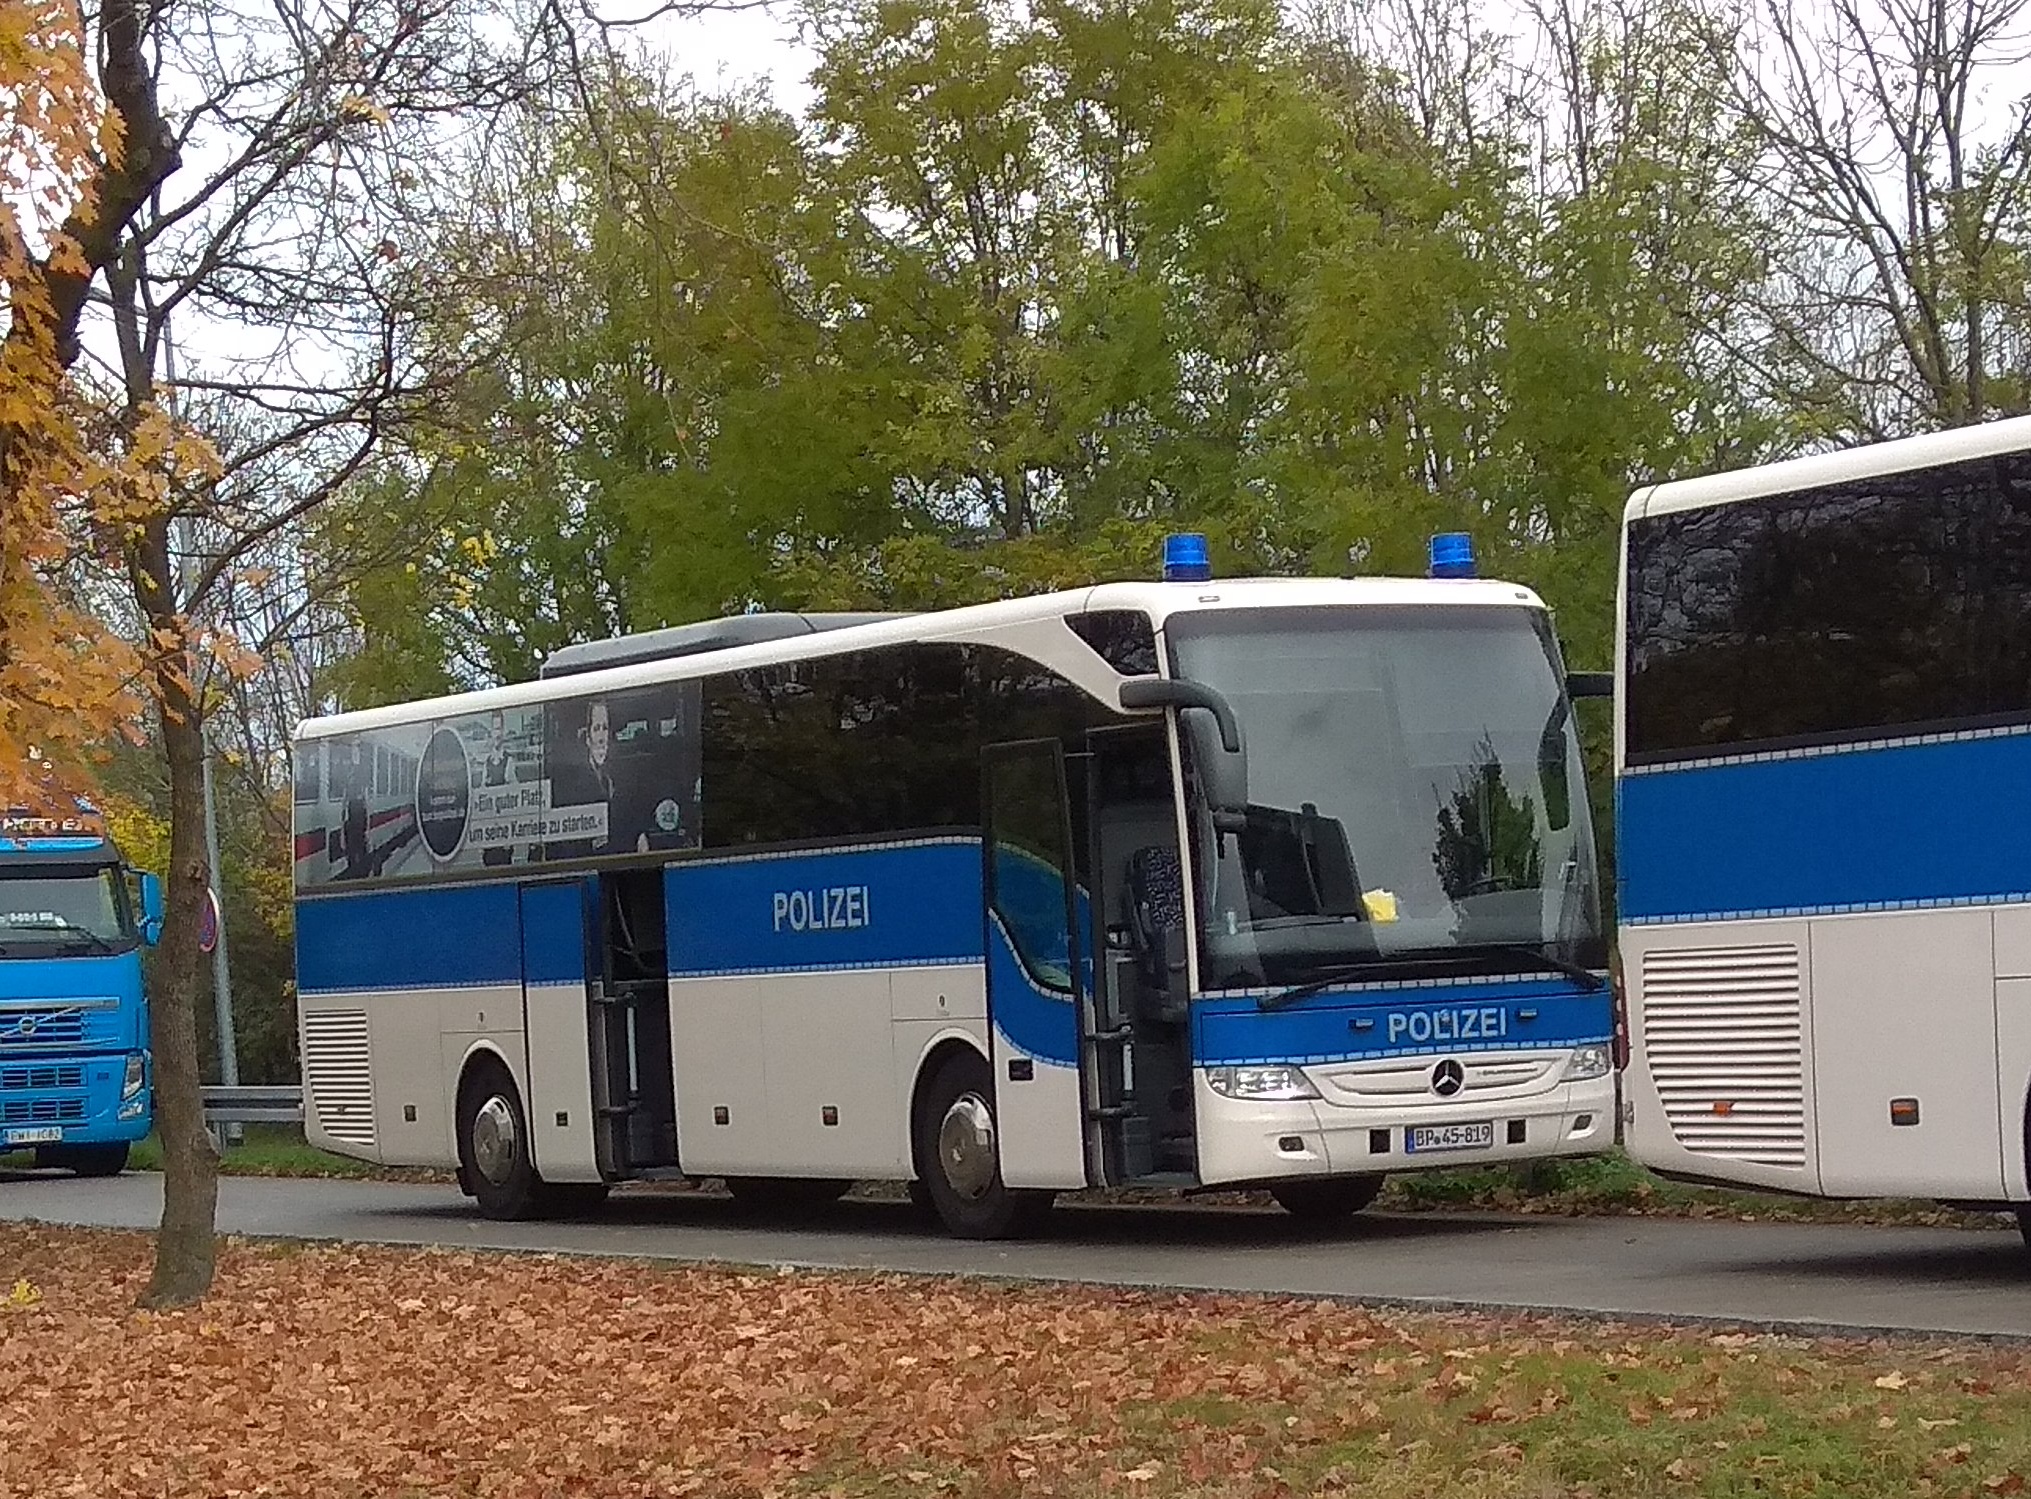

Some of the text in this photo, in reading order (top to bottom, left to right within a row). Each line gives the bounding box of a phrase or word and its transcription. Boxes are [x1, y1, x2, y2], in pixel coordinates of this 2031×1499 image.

[469, 828, 483, 842] um
[485, 823, 509, 841] seine
[548, 820, 560, 835] zu
[773, 885, 870, 932] POLIZEI
[1388, 1007, 1506, 1043] POLIZEI
